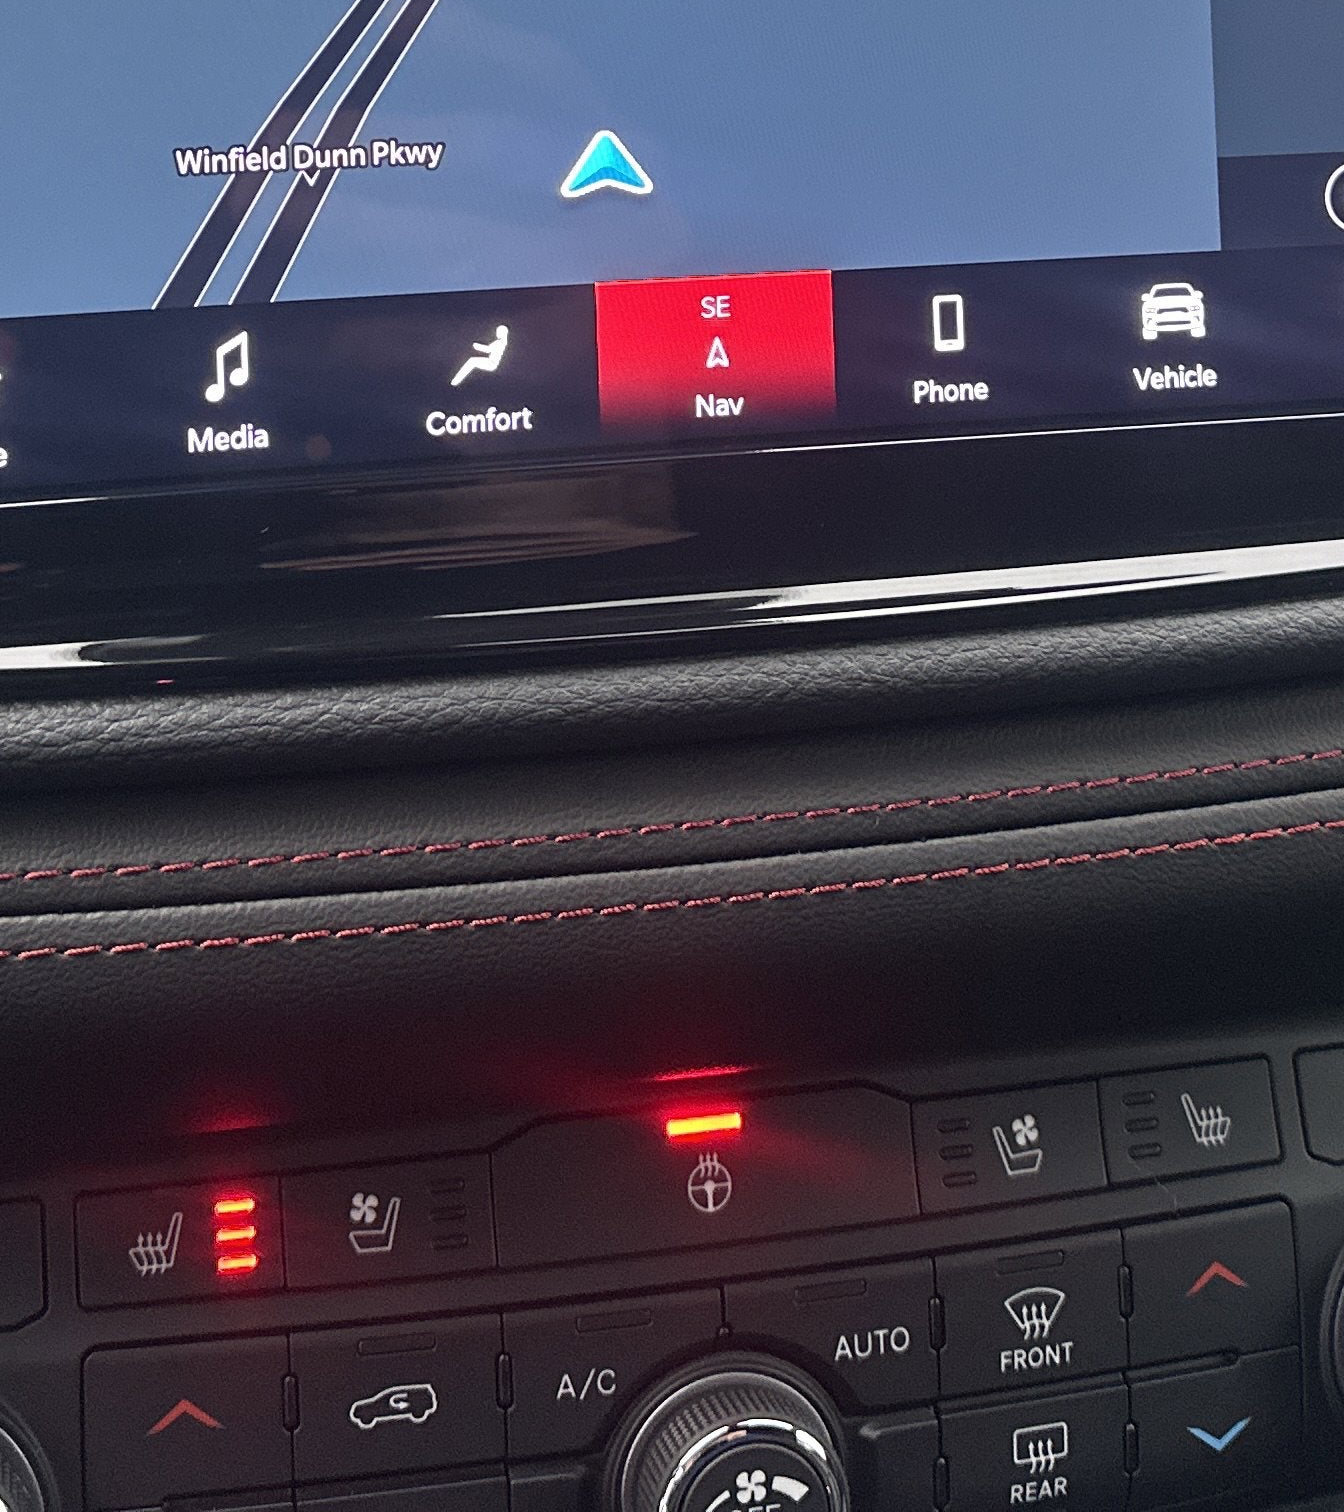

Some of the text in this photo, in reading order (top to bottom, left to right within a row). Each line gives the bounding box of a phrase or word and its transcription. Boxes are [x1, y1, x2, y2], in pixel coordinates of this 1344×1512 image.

[174, 141, 444, 175] Winfield Dunn Pkwy
[700, 296, 732, 320] SE
[912, 377, 989, 404] Phone
[1132, 363, 1219, 392] Vehicle
[425, 405, 533, 438] Comfort
[694, 393, 744, 418] Nav
[186, 424, 270, 456] Media
[834, 1327, 911, 1362] AUTO
[1000, 1340, 1074, 1374] FRONT
[556, 1369, 617, 1402] A/C
[1010, 1476, 1068, 1504] REAR
